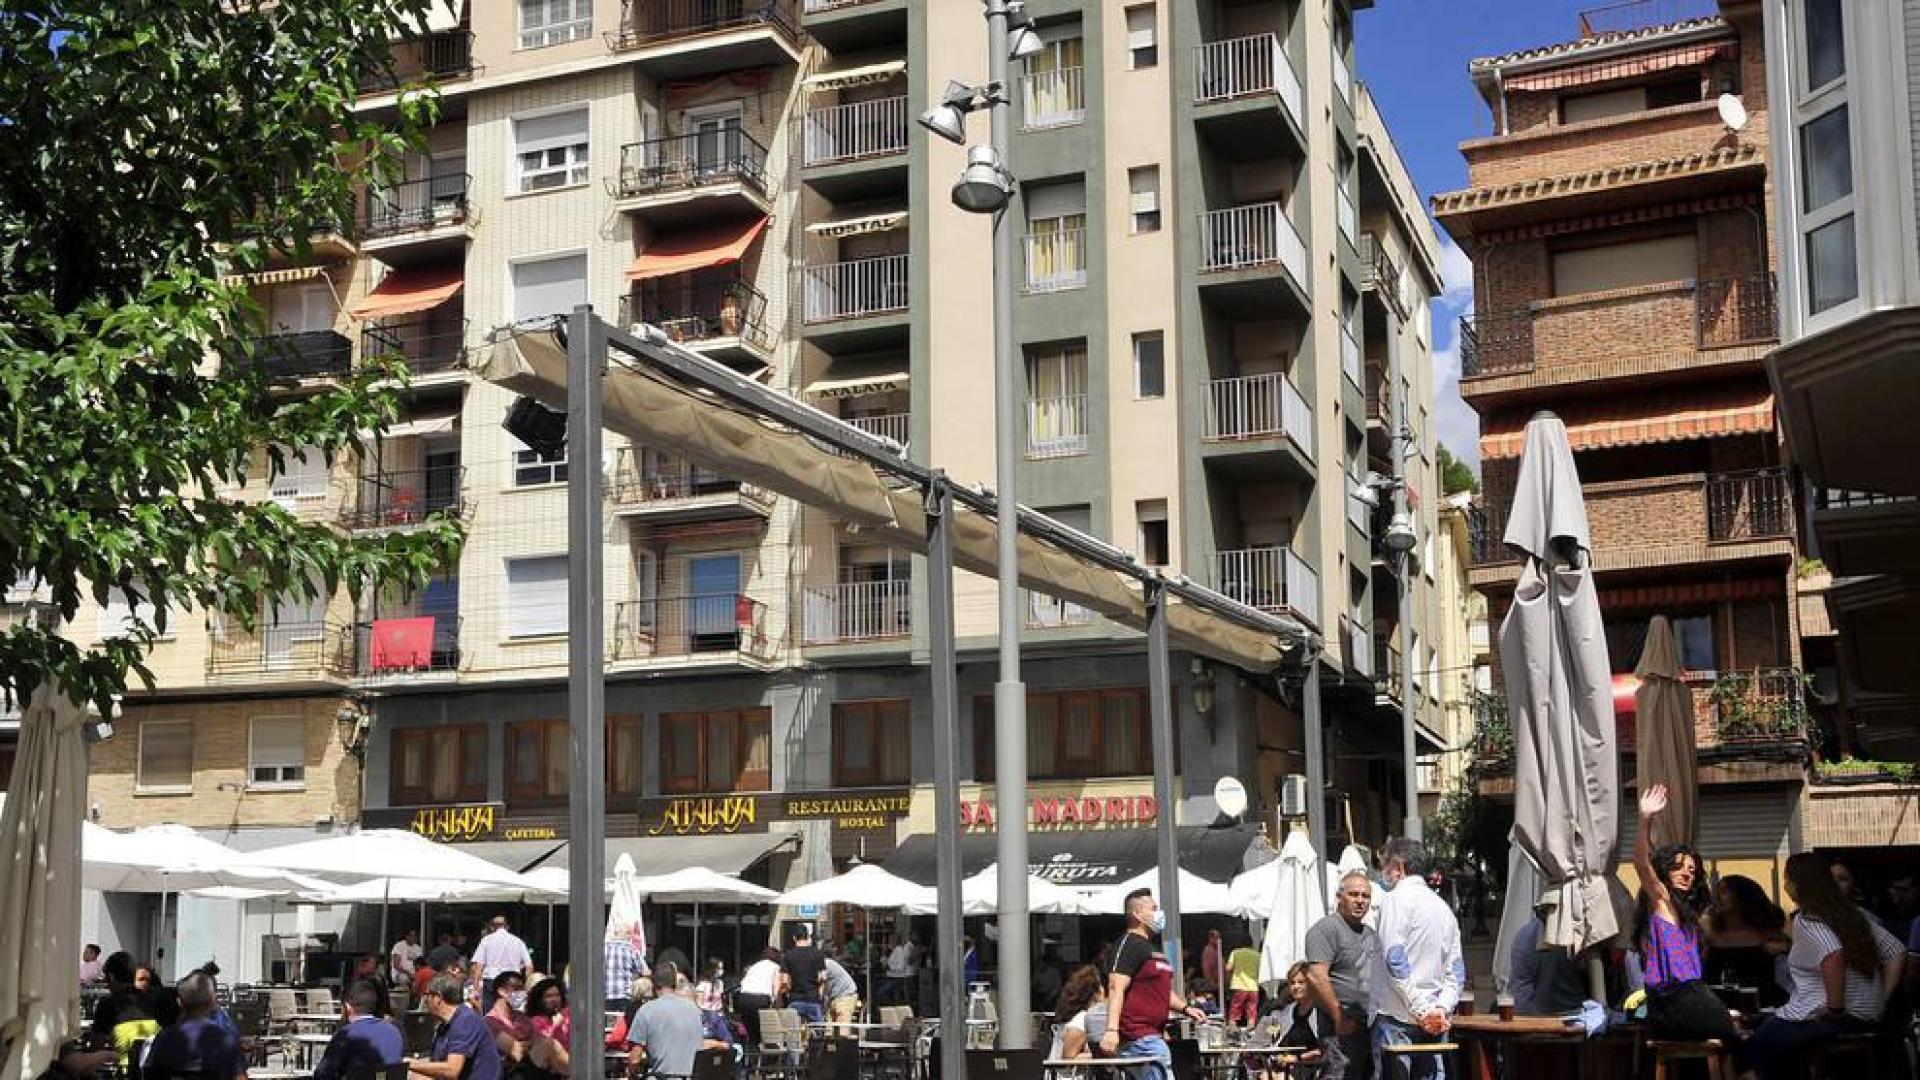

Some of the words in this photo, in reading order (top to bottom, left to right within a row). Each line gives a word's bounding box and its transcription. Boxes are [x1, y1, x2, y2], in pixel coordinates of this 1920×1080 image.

[816, 71, 892, 88] ATALAYA
[817, 218, 895, 237] HOSTAL
[820, 381, 897, 398] ATALAYA
[787, 796, 910, 815] RESTAURANTE
[957, 799, 993, 825] BA
[1032, 794, 1159, 823] MADRID
[410, 805, 494, 841] ATALAYA
[648, 797, 756, 835] ATALAYA
[838, 816, 885, 829] HOSTAL
